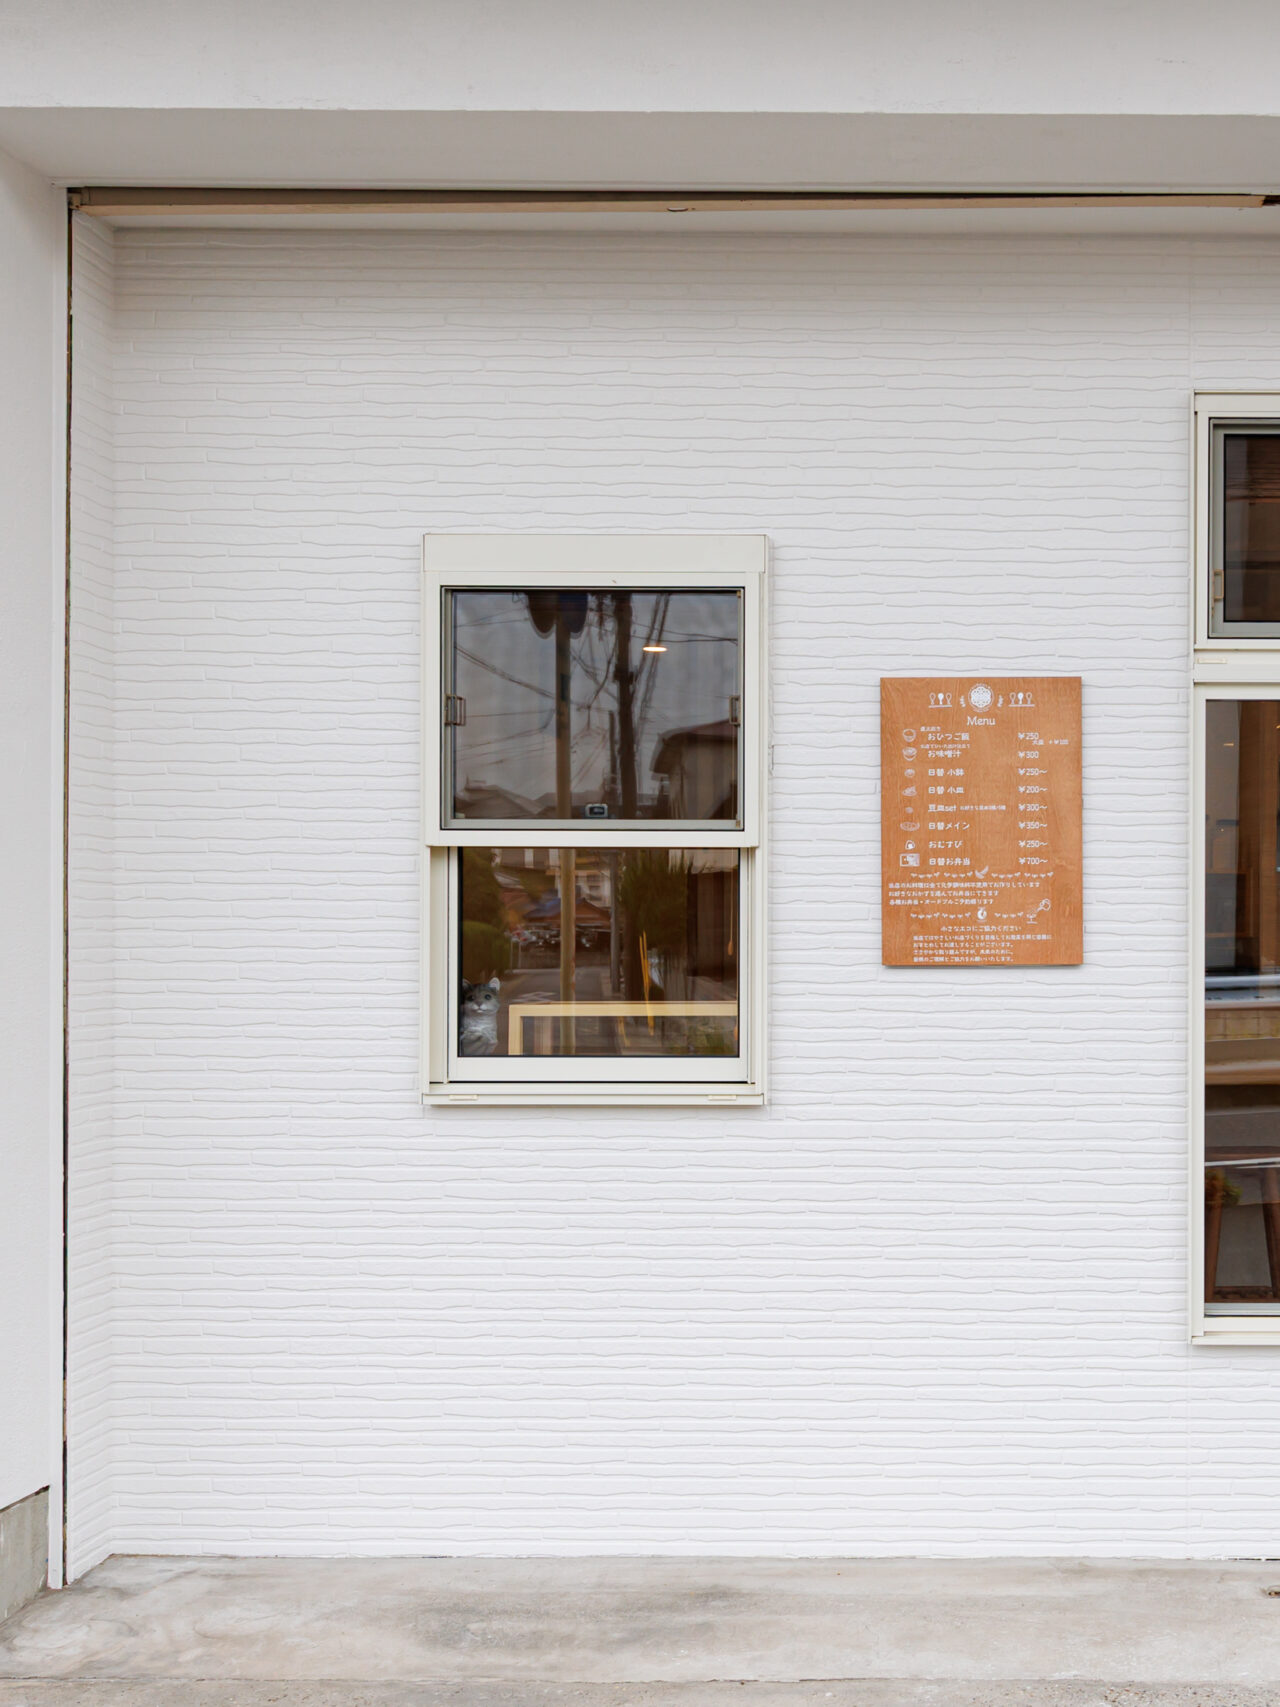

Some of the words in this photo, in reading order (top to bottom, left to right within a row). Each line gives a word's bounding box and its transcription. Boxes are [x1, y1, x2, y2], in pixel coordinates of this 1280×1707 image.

[967, 716, 995, 726] Menu
[928, 732, 970, 741] おひつご飯
[928, 768, 944, 777] 日替
[928, 786, 944, 794] 日替
[928, 821, 970, 830] 日替メイン
[928, 840, 963, 849] おむすび
[929, 857, 970, 866] 日替お弁当
